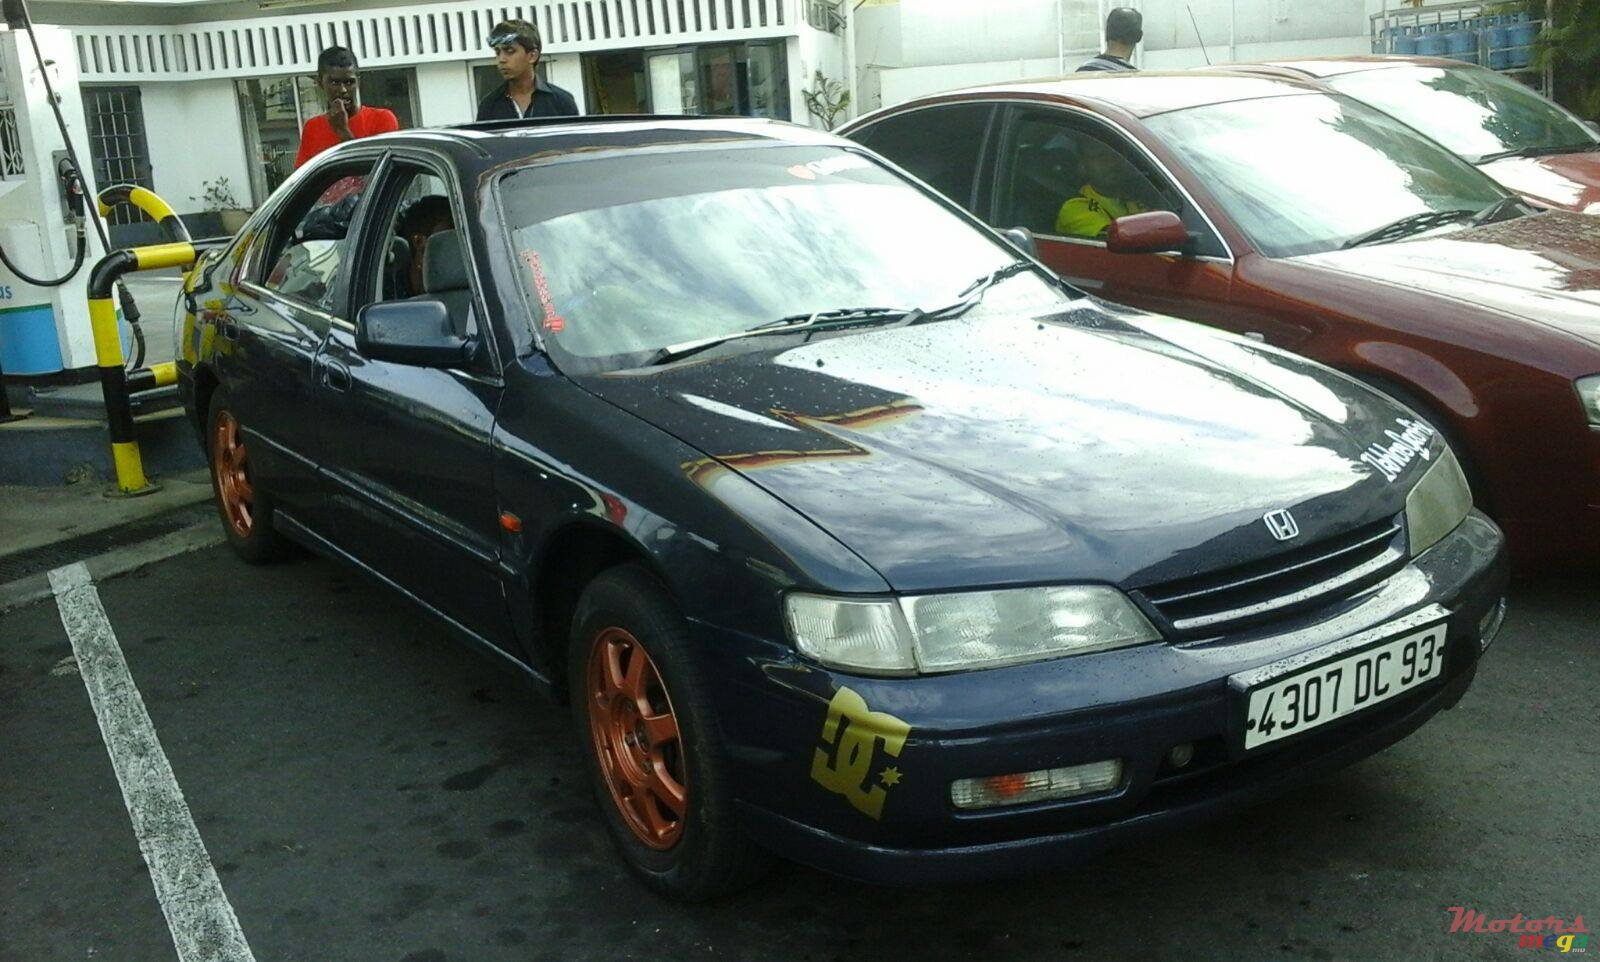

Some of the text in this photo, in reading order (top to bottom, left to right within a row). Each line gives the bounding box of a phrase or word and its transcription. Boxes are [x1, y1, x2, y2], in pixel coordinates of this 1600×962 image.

[1257, 634, 1436, 737] 4307 DC 93
